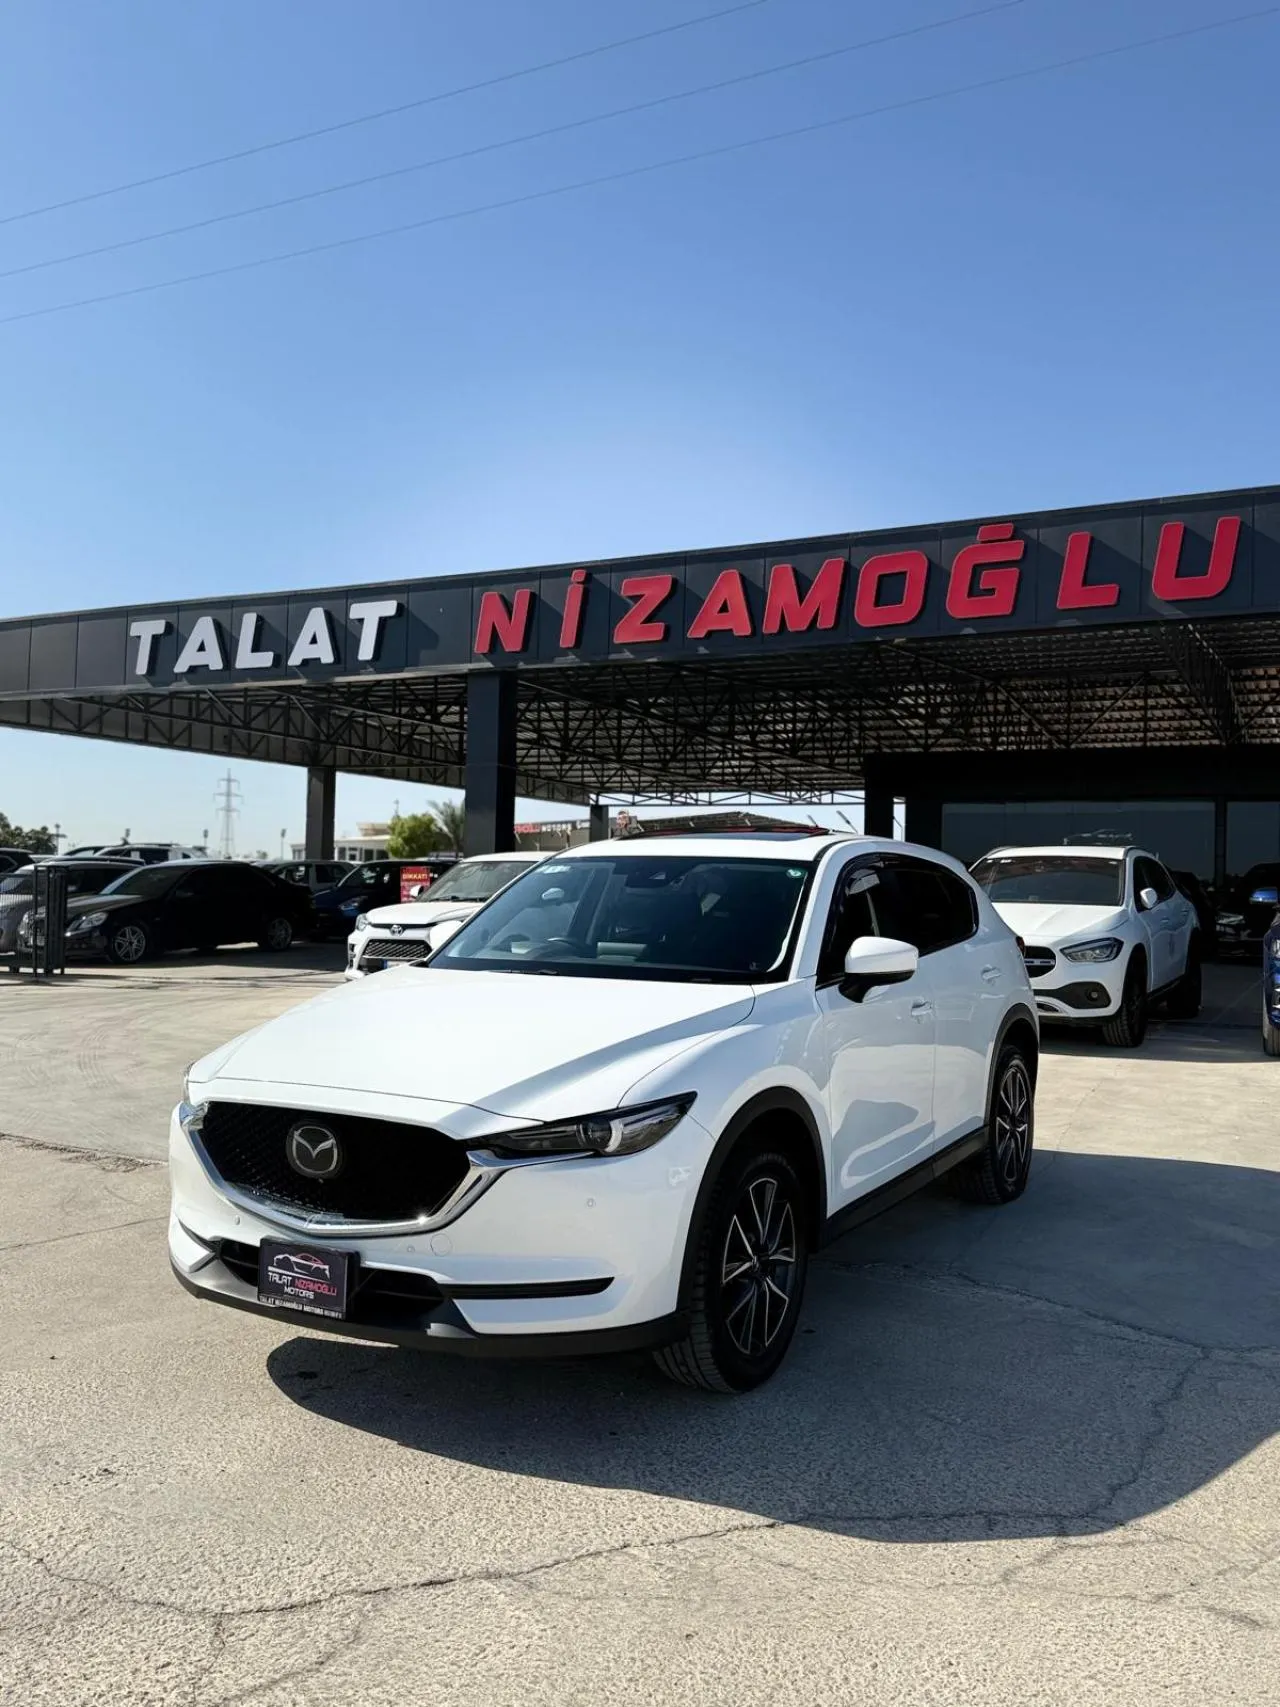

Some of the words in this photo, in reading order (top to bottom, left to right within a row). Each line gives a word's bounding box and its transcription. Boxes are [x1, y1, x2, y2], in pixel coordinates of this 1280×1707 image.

[129, 599, 398, 675] TALAT
[473, 515, 1242, 655] NİZAMOĞLU
[268, 1272, 292, 1285] TALAT
[284, 1286, 314, 1299] MOTORS
